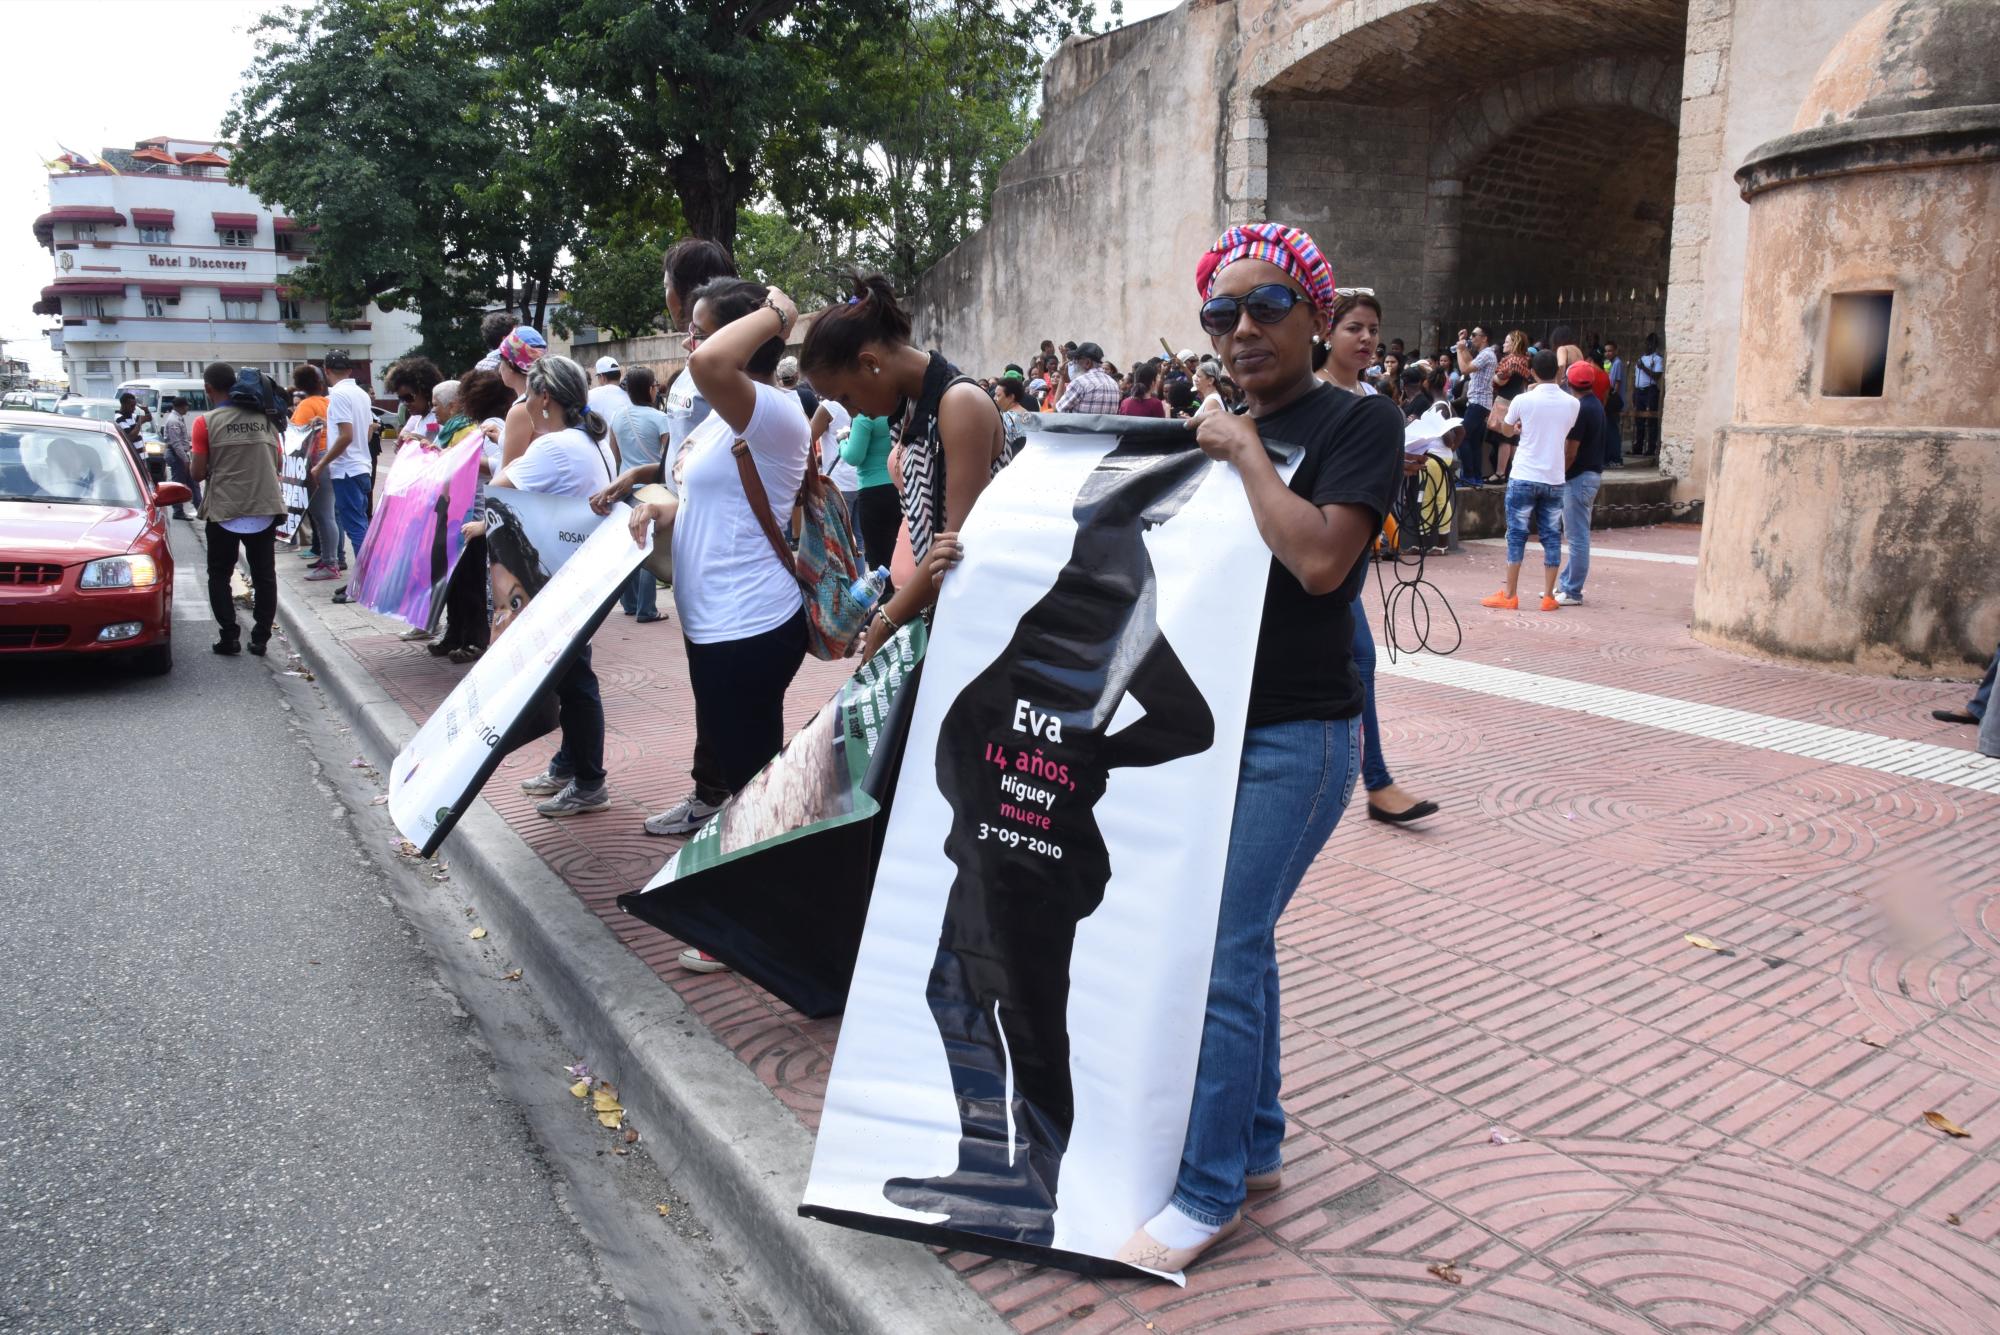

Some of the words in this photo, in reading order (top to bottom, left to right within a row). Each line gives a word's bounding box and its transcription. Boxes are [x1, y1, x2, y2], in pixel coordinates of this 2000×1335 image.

[149, 254, 181, 267] Hotel
[189, 256, 247, 270] Discovery
[226, 422, 266, 434] PRENSA
[862, 704, 875, 725] sus
[1012, 699, 1063, 743] Eva
[985, 743, 1008, 769] 14
[1015, 748, 1076, 792] años,
[1000, 774, 1057, 811] Higuey
[1000, 803, 1051, 830] muere
[977, 822, 1063, 859] 3-09-2010
